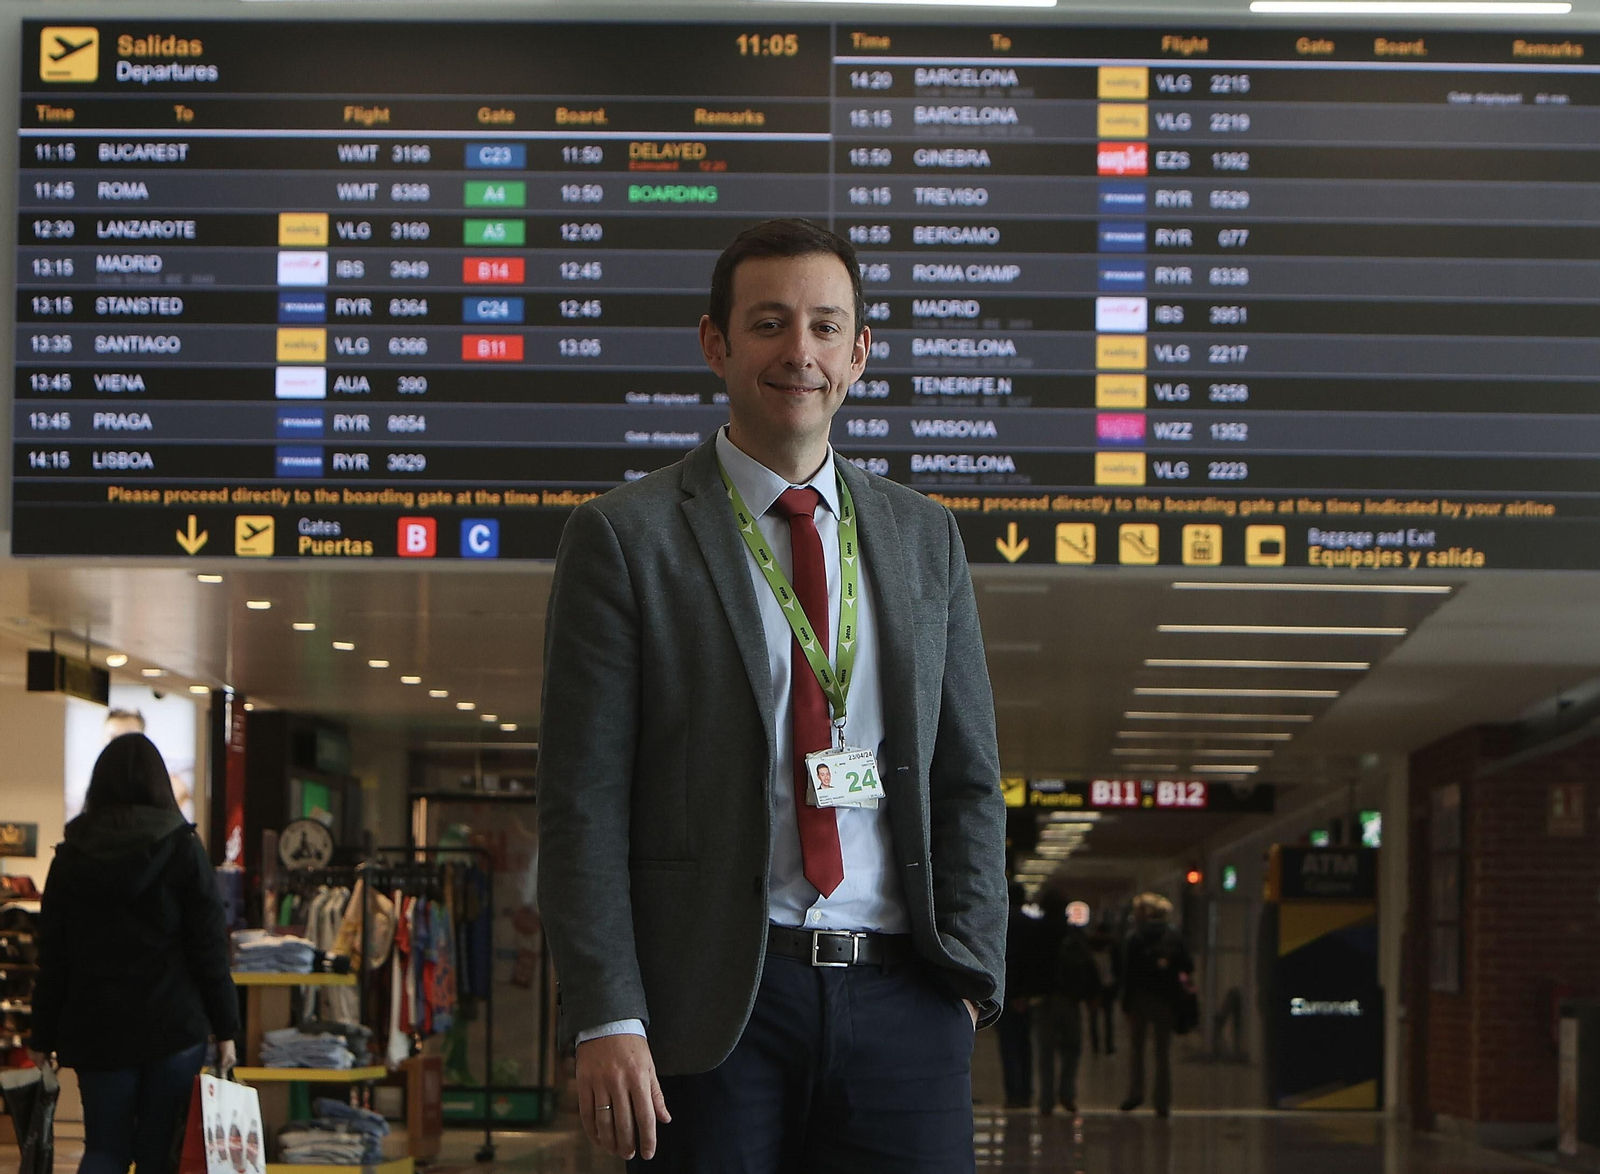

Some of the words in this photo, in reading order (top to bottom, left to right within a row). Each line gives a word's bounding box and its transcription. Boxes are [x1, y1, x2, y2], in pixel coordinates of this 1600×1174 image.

[118, 35, 202, 56] Salidas
[737, 34, 798, 55] 11:05
[852, 32, 890, 49] Time
[991, 34, 1011, 50] To
[1162, 35, 1208, 55] Flight
[1296, 37, 1335, 54] Gate
[1513, 40, 1583, 57] Remarks
[117, 61, 218, 84] Departures
[851, 71, 892, 89] 14:20
[915, 68, 1018, 86] BARCELONA
[1156, 75, 1192, 92] VLG
[37, 105, 74, 120] Time
[174, 105, 194, 121] To
[344, 106, 390, 125] Flight
[478, 107, 516, 125] Gate
[555, 107, 608, 125] Board.
[695, 108, 765, 125] Remarks
[850, 110, 892, 127] 15:15
[914, 106, 1018, 124] BARCELONA
[1156, 113, 1191, 131] VLG
[36, 143, 75, 161] 11:15
[99, 143, 188, 161] BUCAREST
[338, 145, 378, 161] WMT
[479, 145, 512, 165] C23
[562, 146, 603, 163] 11:50
[630, 143, 706, 159] DELAYED
[850, 148, 892, 166] 15:50
[914, 149, 990, 167] GINEBRA
[1156, 151, 1190, 169] EZS
[35, 182, 74, 199] 11:45
[97, 181, 149, 200] ROMA
[337, 183, 378, 200] WMT
[483, 184, 506, 203] A4
[561, 185, 603, 202] 10:50
[629, 185, 717, 202] BOARDING
[849, 187, 891, 204] 16:15
[914, 188, 988, 205] TREVISO
[1156, 190, 1192, 206] RYR
[34, 220, 74, 238] 12:30
[97, 220, 195, 238] LANZAROTE
[337, 222, 371, 239] VLG
[483, 222, 506, 241] A5
[561, 223, 602, 241] 12:00
[913, 226, 1000, 244] BERGAMO
[1155, 229, 1192, 245] RYR
[33, 259, 73, 276] 13:15
[97, 255, 162, 272] MADRID
[336, 260, 364, 278] IBS
[478, 260, 508, 280] B14
[560, 262, 602, 279] 12:45
[912, 264, 964, 283] ROMA
[965, 264, 1021, 283] CIAMP
[1155, 267, 1192, 283] RYR
[32, 297, 73, 314] 13:15
[96, 297, 183, 315] STANSTED
[336, 298, 371, 315] RYR
[477, 300, 508, 318] C24
[560, 300, 601, 318] 12:45
[913, 300, 980, 317] MADRID
[1155, 306, 1184, 323] IBS
[31, 335, 72, 352] 13:35
[95, 336, 181, 353] SANTIAGO
[335, 337, 370, 354] VLG
[475, 339, 508, 358] B11
[559, 339, 601, 356] 13:05
[912, 339, 1016, 356] BARCELONA
[1154, 345, 1190, 362] VLG
[1209, 345, 1248, 363] 2217
[31, 374, 71, 391] 13:45
[94, 374, 145, 392] VIENA
[334, 376, 370, 393] AUA
[913, 377, 1011, 395] TENERIFE.N
[1154, 384, 1190, 401] VLG
[30, 413, 71, 429] 13:45
[94, 413, 152, 430] PRAGA
[334, 414, 369, 431] RYR
[847, 419, 889, 436] 18:50
[911, 420, 997, 437] VARSOVIA
[1154, 422, 1192, 440] WZZ
[29, 451, 70, 468] 14:15
[93, 452, 154, 469] LISBOA
[333, 453, 369, 470] RYR
[911, 455, 1015, 472] BARCELONA
[1154, 462, 1189, 479] VLG
[108, 486, 160, 502] Please
[164, 488, 228, 505] proceed
[232, 487, 291, 506] directly
[294, 489, 311, 504] to
[314, 489, 340, 503] the
[343, 488, 414, 508] boarding
[418, 491, 452, 508] gate
[456, 491, 471, 504] at
[475, 490, 500, 504] the
[504, 490, 539, 505] time
[542, 490, 603, 506] indicat
[983, 495, 1049, 513] proceed
[1052, 495, 1112, 514] directly
[1115, 497, 1133, 511] to
[1135, 497, 1161, 512] the
[1164, 497, 1236, 516] boarding
[1239, 499, 1275, 516] gate
[1278, 500, 1294, 513] at
[1297, 498, 1323, 513] the
[1326, 499, 1361, 514] time
[1365, 499, 1438, 515] indicated
[1441, 500, 1462, 518] by
[1465, 503, 1502, 519] your
[1505, 501, 1555, 516] airline
[298, 518, 341, 535] Gates
[298, 536, 373, 556] Puertas
[407, 525, 426, 552] B
[469, 524, 490, 553] C
[1307, 527, 1374, 549] Baggage
[1376, 528, 1405, 546] and
[1406, 528, 1436, 547] Exit
[1308, 545, 1404, 568] Equipajes
[1408, 549, 1420, 569] y
[1426, 547, 1485, 568] salida
[848, 752, 873, 761] 23/04/24
[845, 768, 878, 793] 24
[1091, 780, 1139, 805] B11
[1157, 781, 1206, 806] B12
